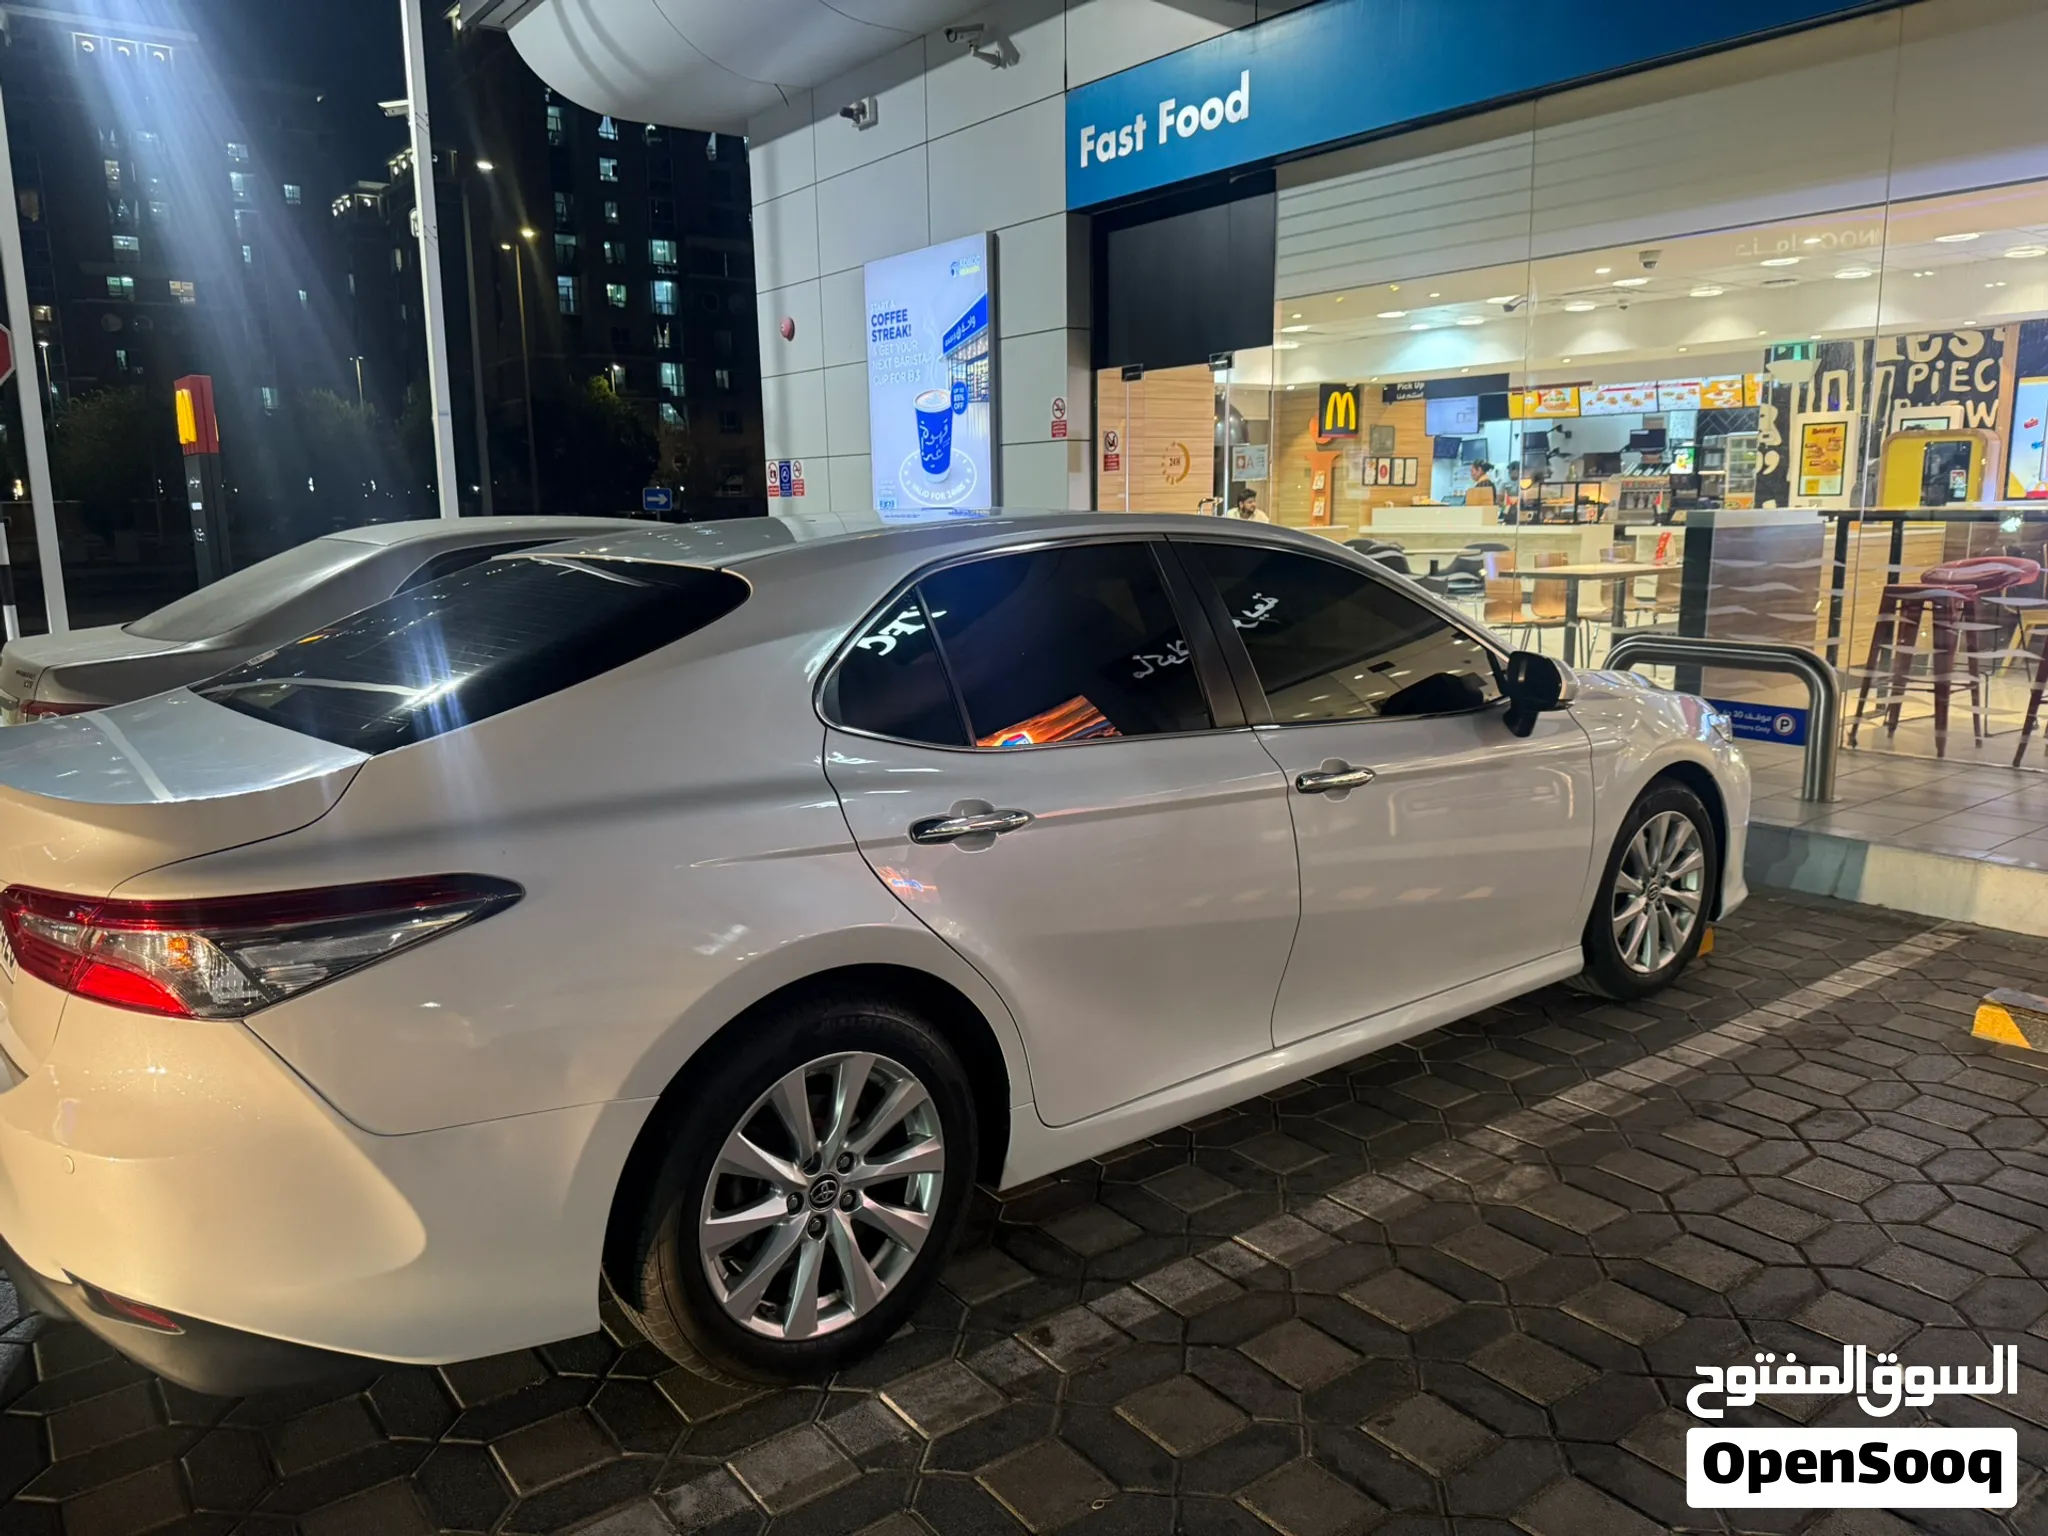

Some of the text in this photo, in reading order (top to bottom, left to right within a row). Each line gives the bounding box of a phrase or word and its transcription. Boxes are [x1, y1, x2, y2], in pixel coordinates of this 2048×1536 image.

[1080, 69, 1250, 168] Fast Food
[871, 308, 908, 327] COFFEE
[871, 324, 912, 343] STREAK!
[879, 342, 894, 356] GET
[895, 339, 919, 353] YOUR
[872, 354, 929, 371] NEXT BARISTA
[890, 371, 907, 384] FOR
[1396, 381, 1425, 391] Pick Up
[953, 402, 965, 410] OFF
[1755, 725, 1772, 735] Only
[1780, 719, 1789, 730] P
